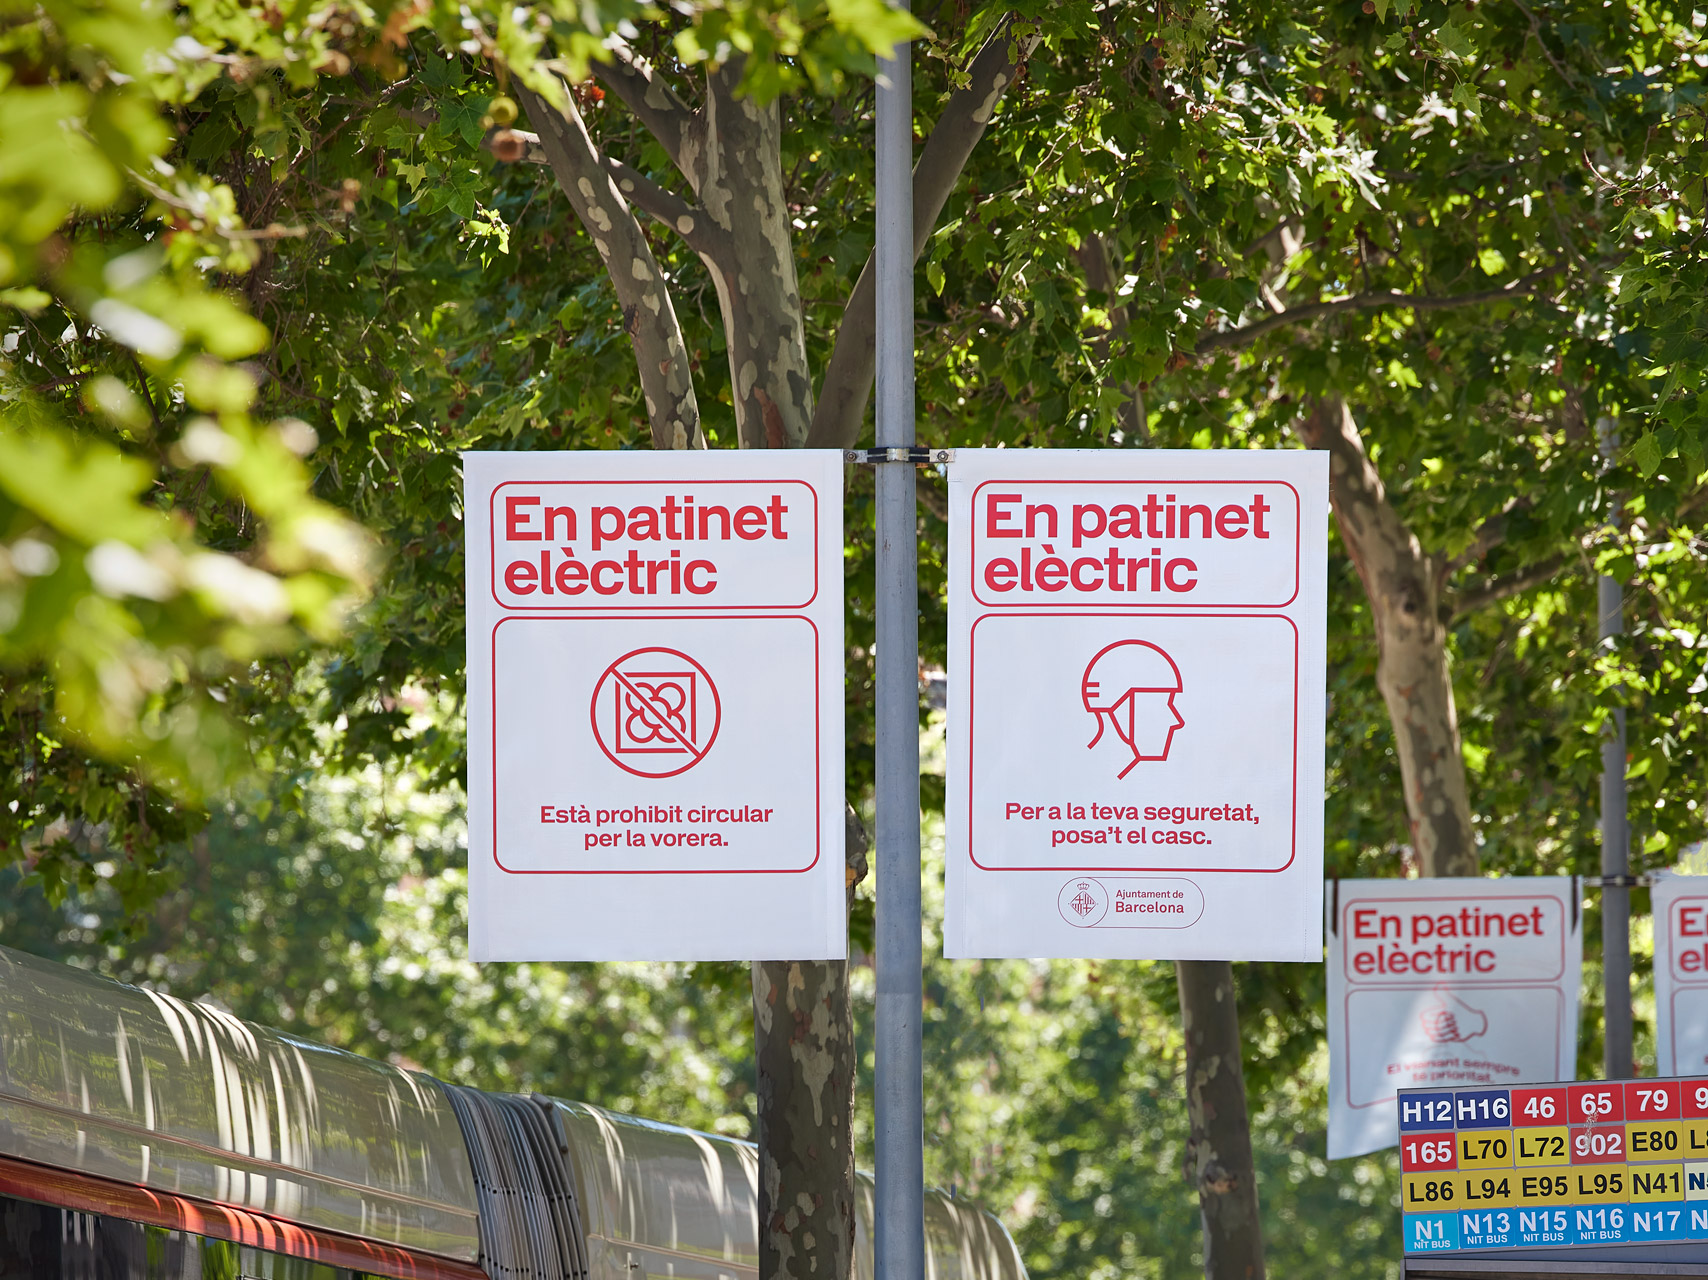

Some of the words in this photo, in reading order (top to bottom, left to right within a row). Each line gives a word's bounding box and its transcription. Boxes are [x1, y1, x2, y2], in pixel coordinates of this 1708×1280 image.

[506, 496, 577, 542] En
[592, 495, 789, 551] patinet
[986, 494, 1058, 539] En
[1072, 494, 1271, 548] patinet
[504, 546, 718, 596] elèctric
[984, 543, 1198, 593] elèctric
[540, 804, 591, 824] Està
[596, 805, 683, 827] prohibit
[688, 804, 774, 824] circular
[1005, 802, 1045, 820] Per
[1048, 806, 1062, 820] a
[1066, 802, 1086, 820] la
[1090, 803, 1139, 821] teva
[1144, 803, 1260, 825] seguretat,
[584, 833, 623, 851] per
[626, 829, 646, 847] la
[651, 832, 729, 847] vorera.
[1127, 827, 1147, 844] el
[1151, 830, 1212, 845] casc.
[1115, 901, 1185, 914] Barcelona
[1116, 889, 1170, 900] Ajuntament
[1172, 890, 1184, 899] de
[1353, 909, 1403, 939] En
[1411, 906, 1546, 945] patinet
[1680, 907, 1708, 936] E
[1353, 943, 1497, 975] elèctric
[1403, 1101, 1452, 1123] H12
[1457, 1098, 1509, 1121] H16
[1524, 1096, 1556, 1119] 46
[1581, 1092, 1612, 1115] 65
[1636, 1089, 1669, 1112] 79
[1405, 1141, 1453, 1164] 165
[1463, 1139, 1507, 1160] L70
[1519, 1136, 1565, 1158] L72
[1575, 1133, 1622, 1157] 902
[1632, 1130, 1678, 1152] E80
[1409, 1180, 1454, 1203] L86
[1466, 1178, 1511, 1200] L94
[1522, 1176, 1568, 1198] E95
[1578, 1173, 1623, 1195] L95
[1633, 1172, 1680, 1195] N41
[1415, 1219, 1444, 1240] N1
[1463, 1212, 1511, 1235] N13
[1519, 1210, 1568, 1233] N15
[1576, 1208, 1624, 1231] N16
[1633, 1210, 1681, 1233] N17
[1523, 1233, 1540, 1243] NIT
[1542, 1232, 1564, 1242] BUS
[1580, 1231, 1597, 1240] NIT
[1599, 1230, 1621, 1239] BUS
[1414, 1240, 1429, 1250] NIT
[1431, 1239, 1451, 1249] BUS
[1467, 1235, 1483, 1245] NIT
[1486, 1234, 1508, 1244] BUS
